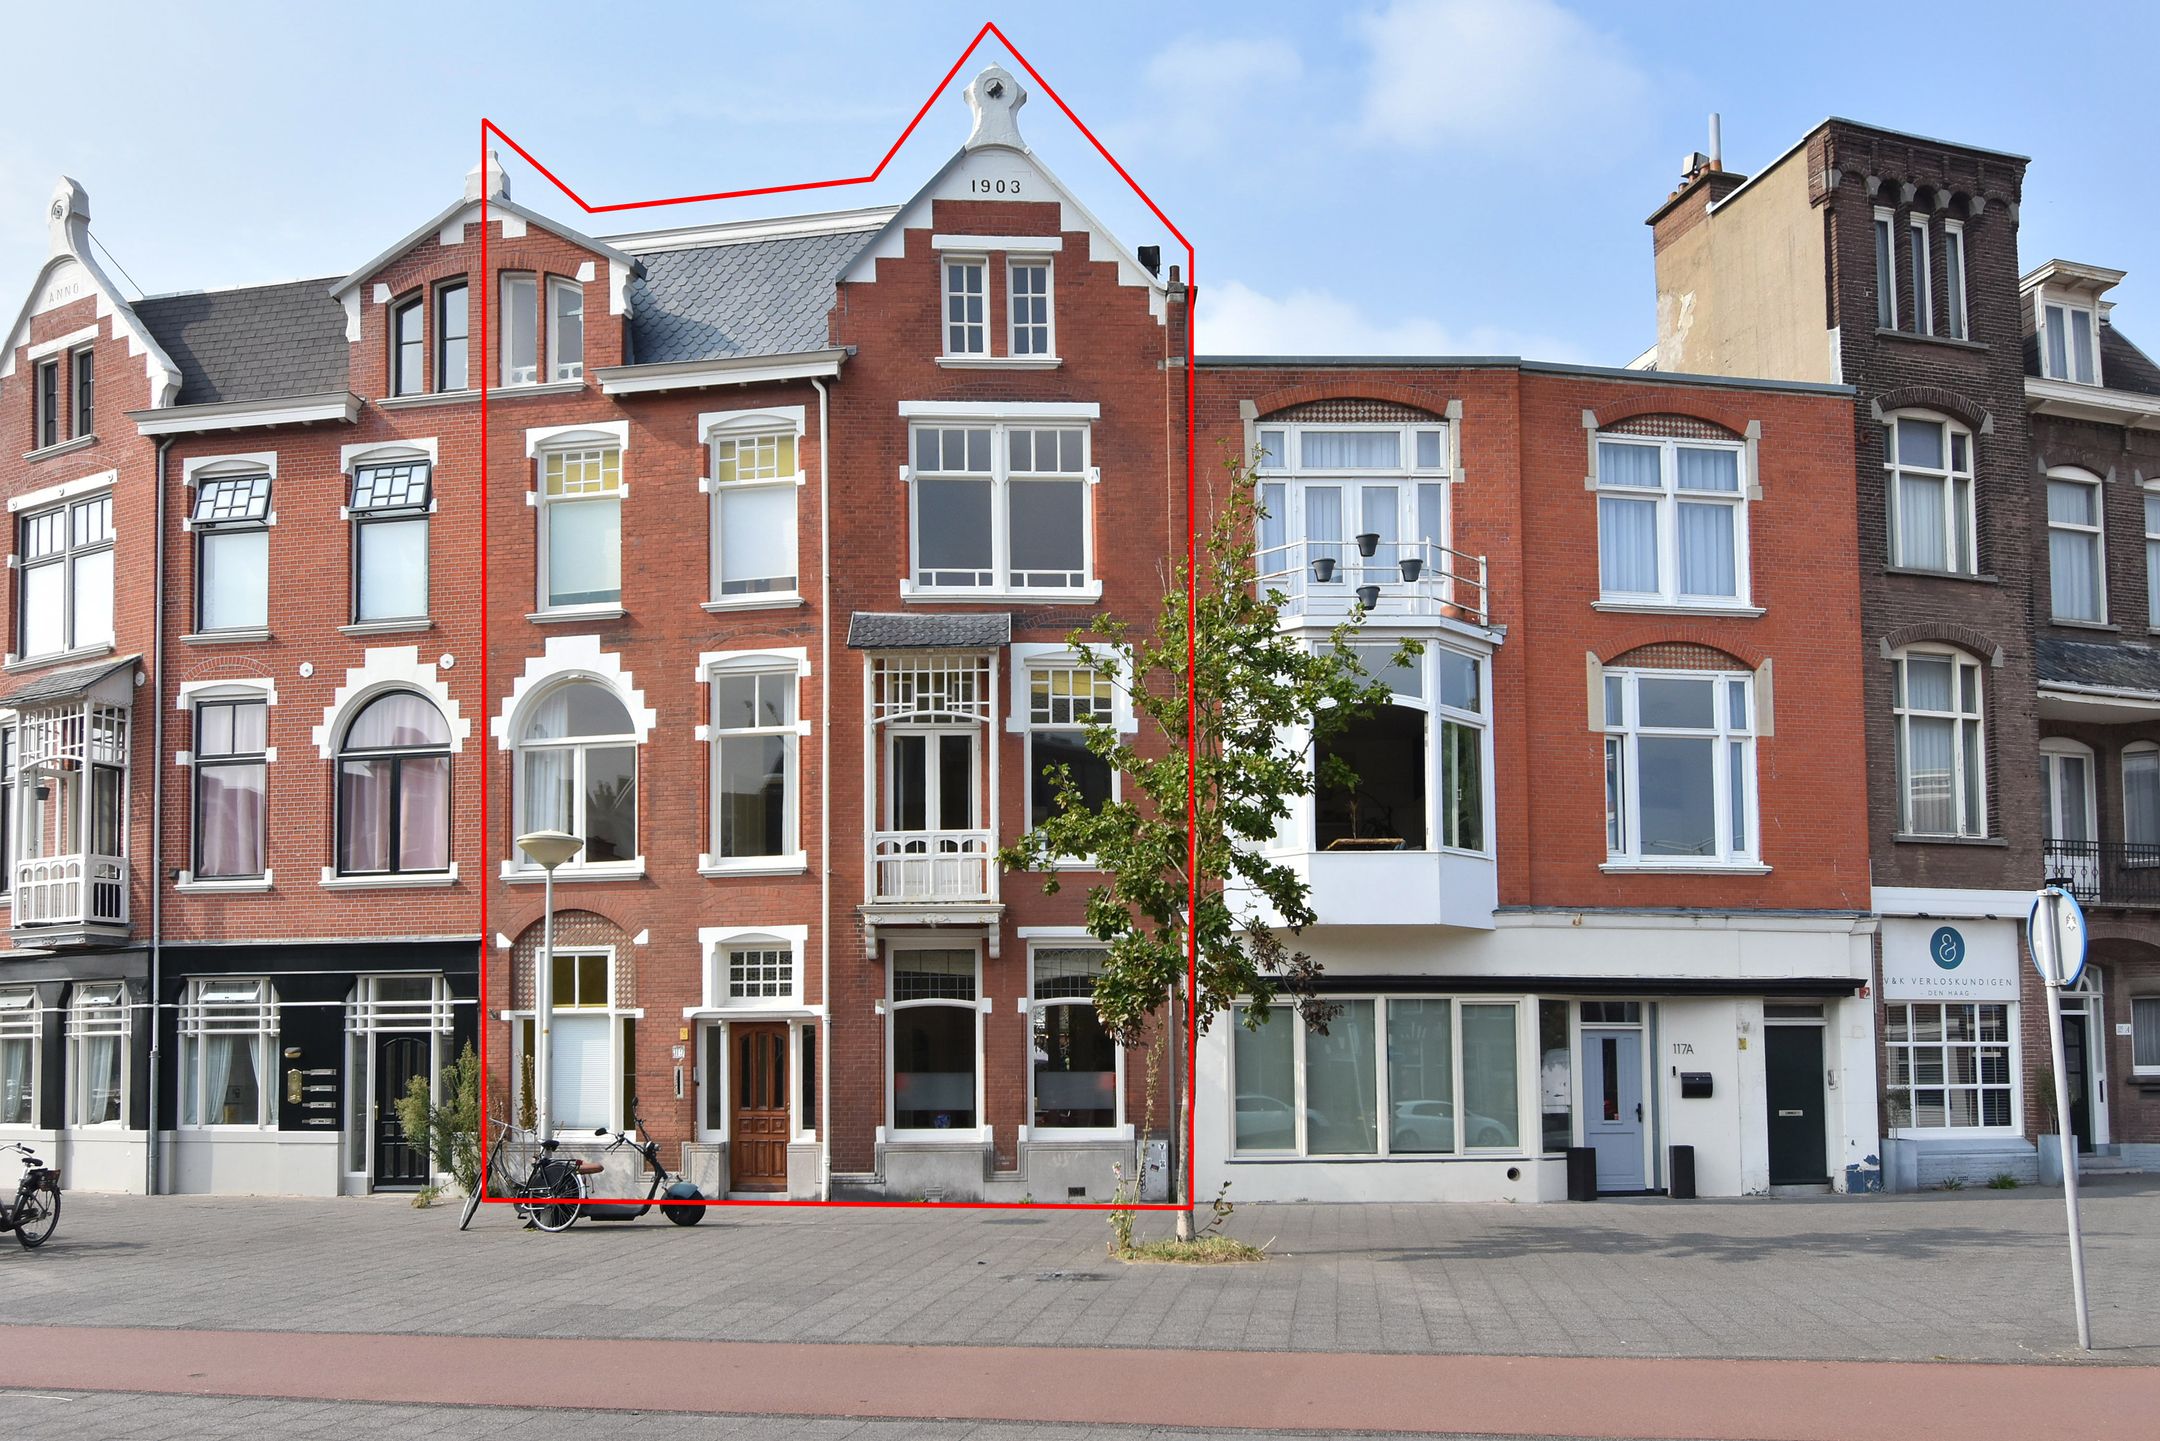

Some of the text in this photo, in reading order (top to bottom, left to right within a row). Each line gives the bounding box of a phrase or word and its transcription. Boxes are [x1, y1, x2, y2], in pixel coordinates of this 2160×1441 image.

[972, 179, 1020, 194] 1903
[49, 283, 79, 303] ANNO
[1884, 977, 2012, 987] V&K VERLOSKUNDIGEN
[1673, 1043, 1694, 1055] 117A
